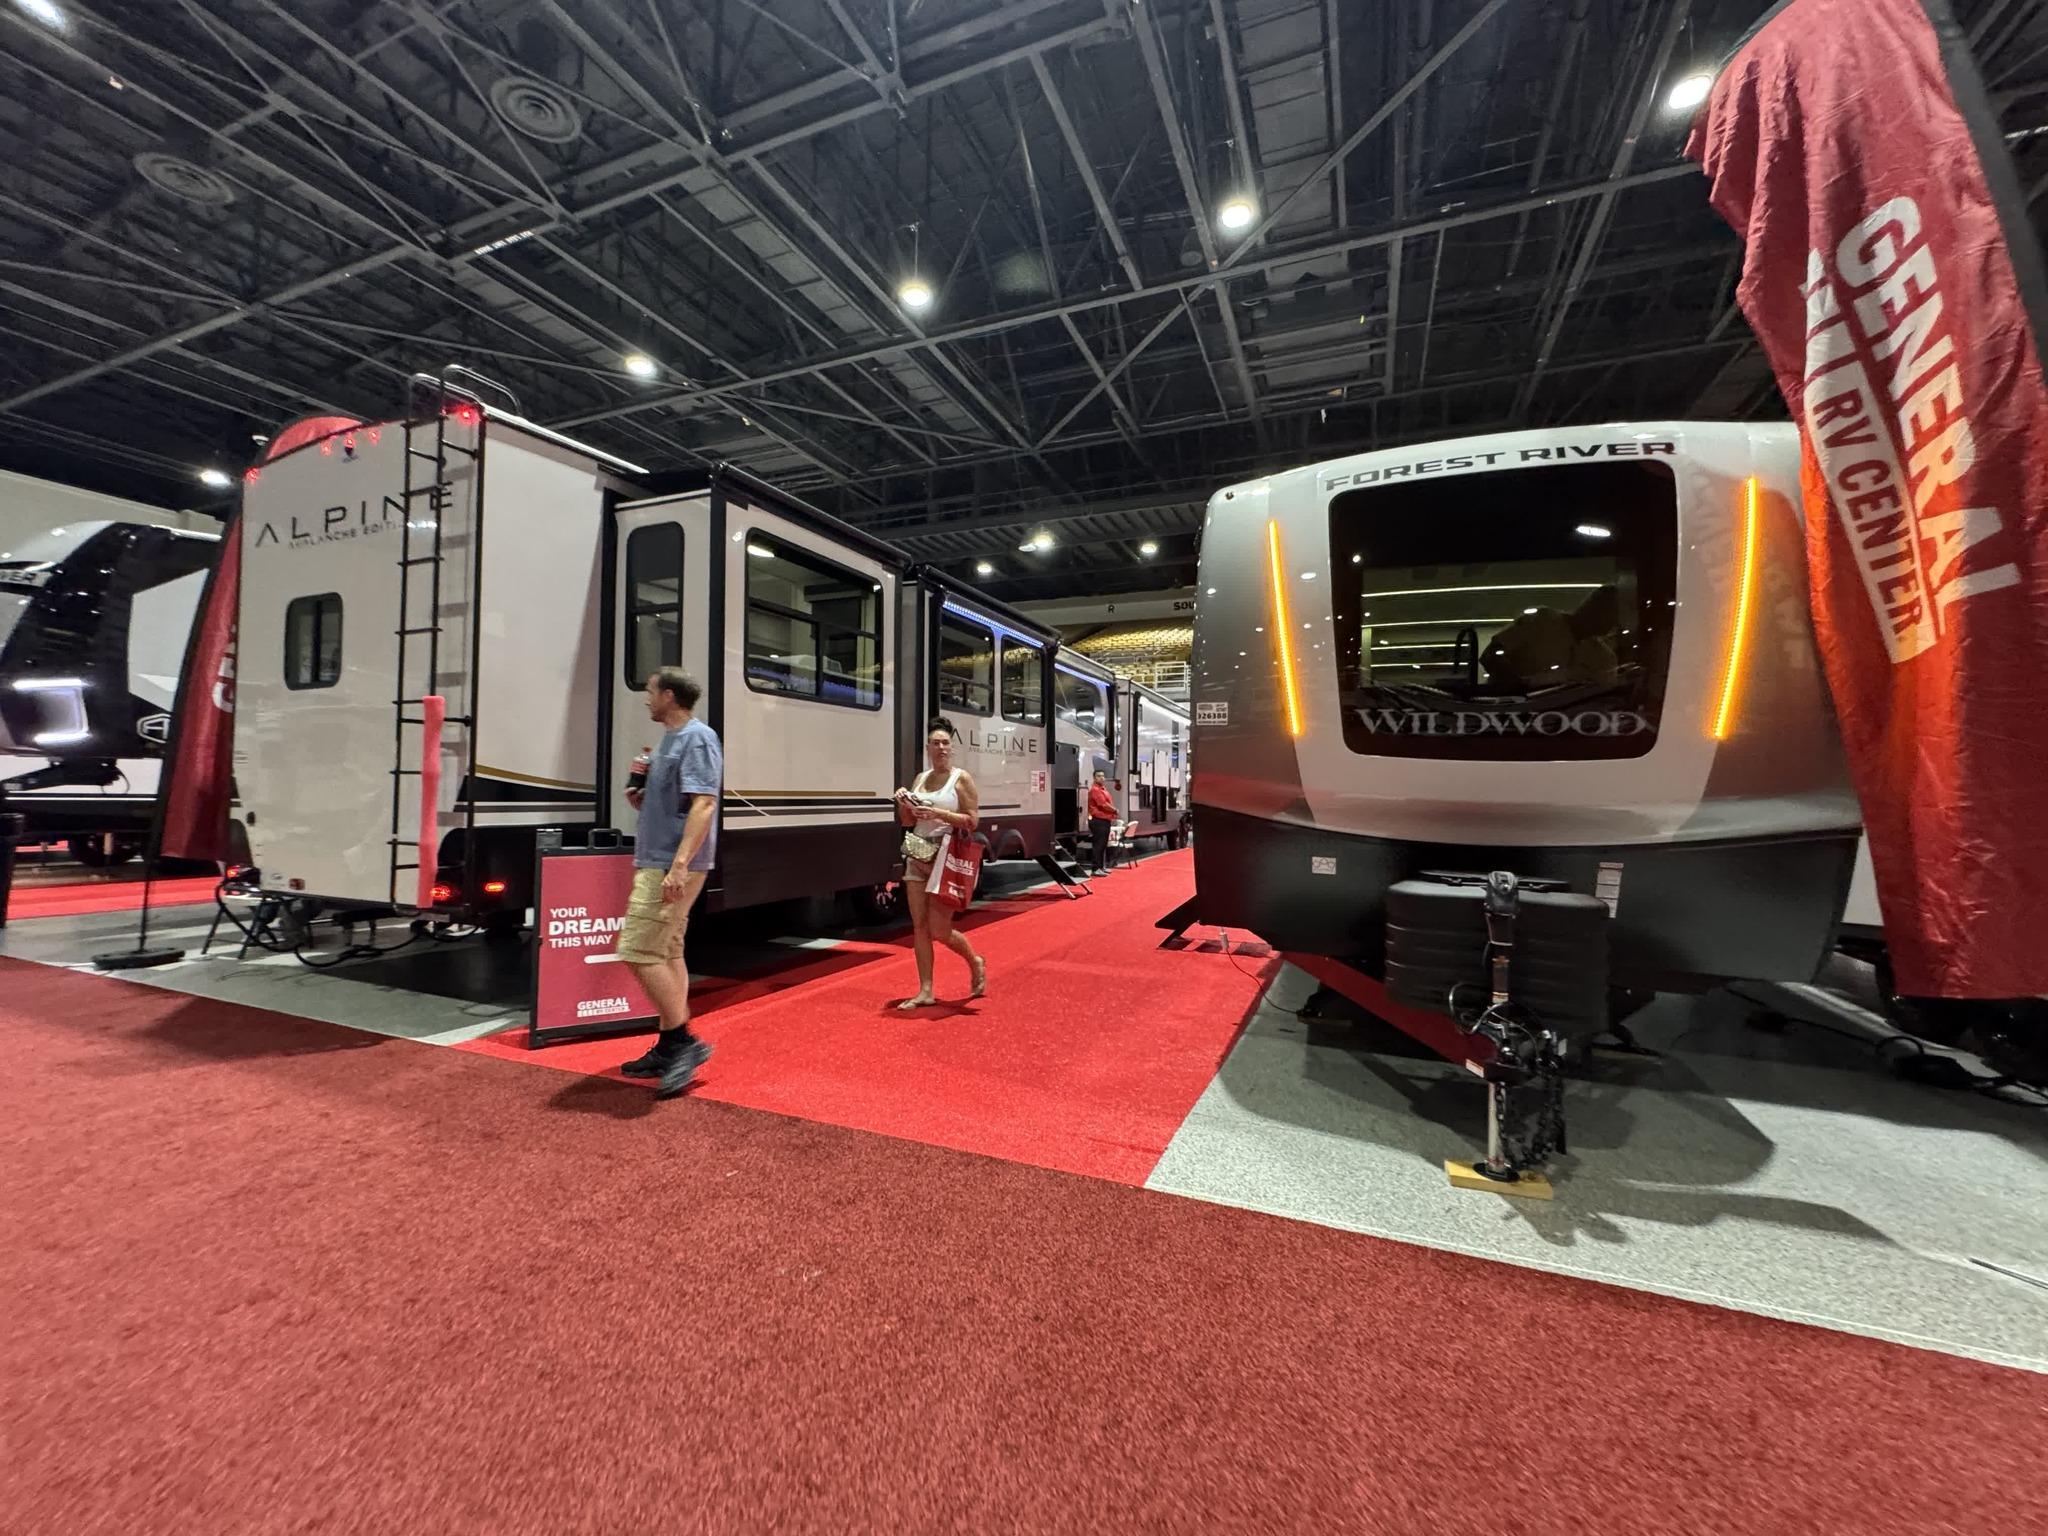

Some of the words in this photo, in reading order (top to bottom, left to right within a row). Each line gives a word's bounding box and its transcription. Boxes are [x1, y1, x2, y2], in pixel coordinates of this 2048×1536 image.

[1812, 387, 1878, 450] RV
[1836, 196, 2021, 636] GENERAL
[1325, 452, 1506, 491] FOREST
[1519, 442, 1677, 463] RIVER
[1837, 456, 1926, 638] CENTER
[1107, 604, 1115, 613] R
[1353, 708, 1648, 736] WILDWOOD
[950, 727, 1037, 753] ALPINE
[550, 906, 587, 918] YOUR
[548, 917, 626, 936] DREAM
[549, 936, 581, 948] THIS
[583, 934, 613, 946] WAY
[577, 996, 629, 1011] GENERAL
